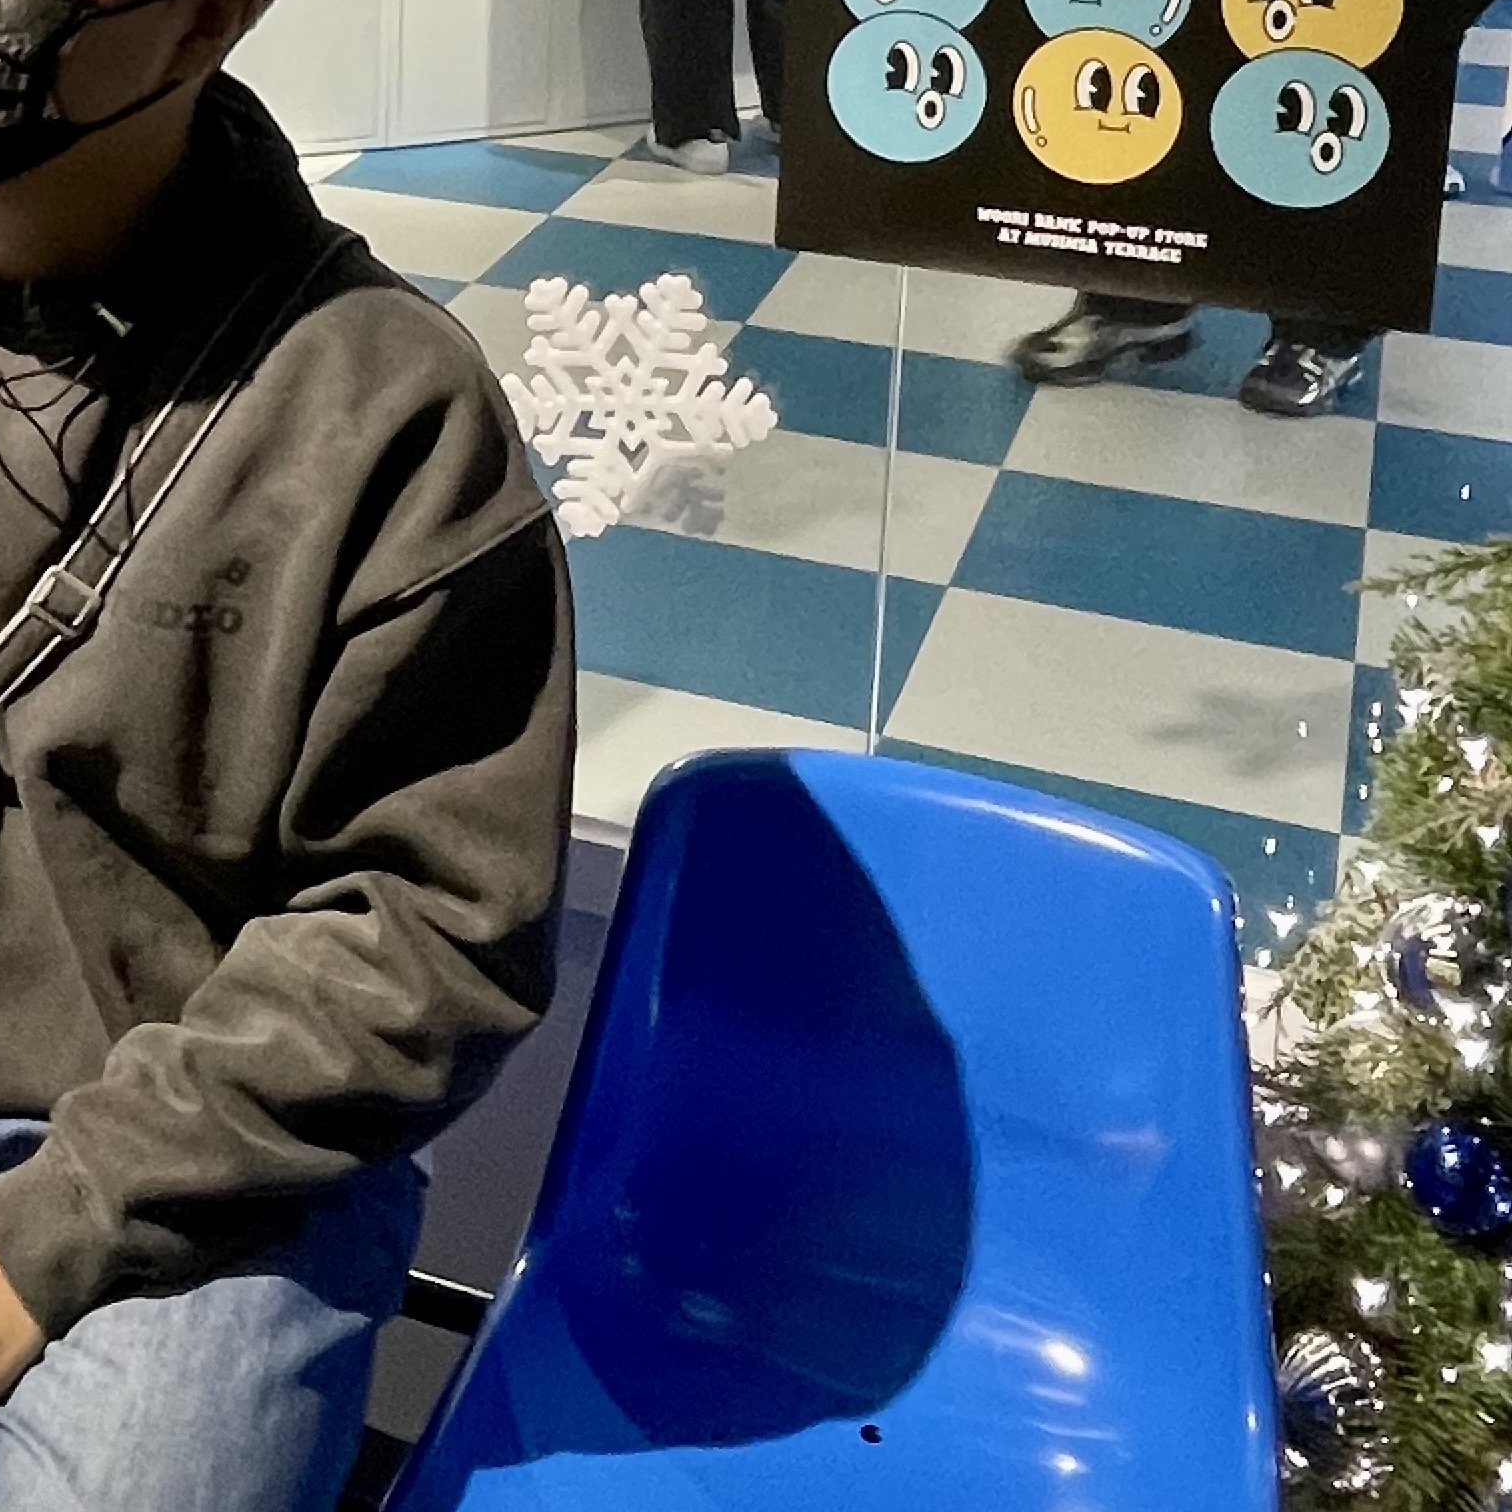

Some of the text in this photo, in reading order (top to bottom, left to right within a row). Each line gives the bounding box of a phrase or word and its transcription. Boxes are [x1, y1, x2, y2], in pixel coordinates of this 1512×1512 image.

[996, 226, 1022, 245] AT
[1102, 240, 1183, 264] TERRACE
[1086, 219, 1150, 241] POP-UP
[1154, 228, 1209, 250] STORE
